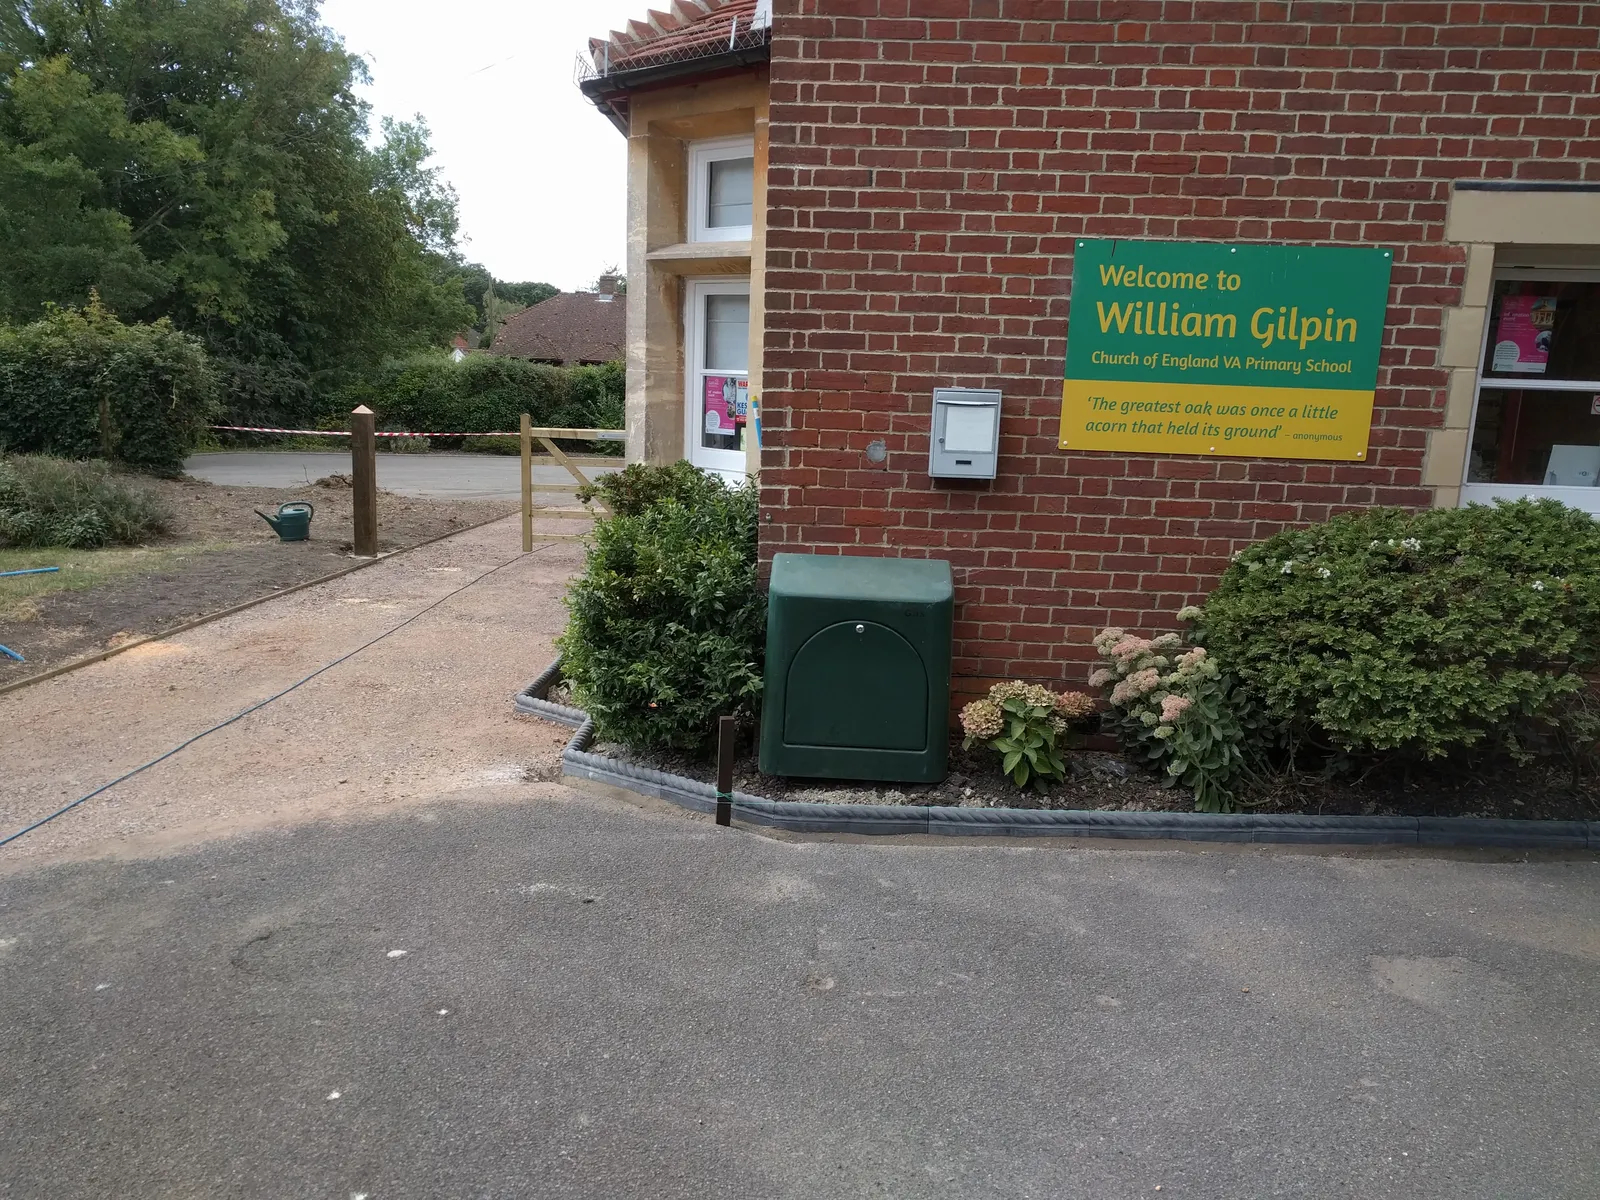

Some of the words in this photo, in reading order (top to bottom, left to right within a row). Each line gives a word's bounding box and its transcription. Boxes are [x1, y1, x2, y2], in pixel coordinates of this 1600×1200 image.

[1099, 264, 1209, 289] Welcome
[1217, 270, 1241, 291] to
[1096, 301, 1237, 338] William
[1250, 306, 1358, 350] Gilpin
[1091, 351, 1139, 365] Church
[1143, 353, 1159, 369] of
[1161, 354, 1219, 371] England
[1223, 356, 1241, 369] VA
[1245, 357, 1302, 375] Primary
[1305, 359, 1352, 373] School
[1120, 400, 1182, 415] greatest
[1184, 401, 1213, 416] oak
[1216, 404, 1247, 416] was
[1250, 405, 1286, 418] once
[1288, 407, 1299, 418] a
[1301, 404, 1339, 420] little
[1085, 421, 1127, 433] acorn
[1131, 420, 1164, 434] that
[1166, 421, 1200, 436] held
[1202, 422, 1221, 437] its
[1292, 432, 1343, 443] anonymous
